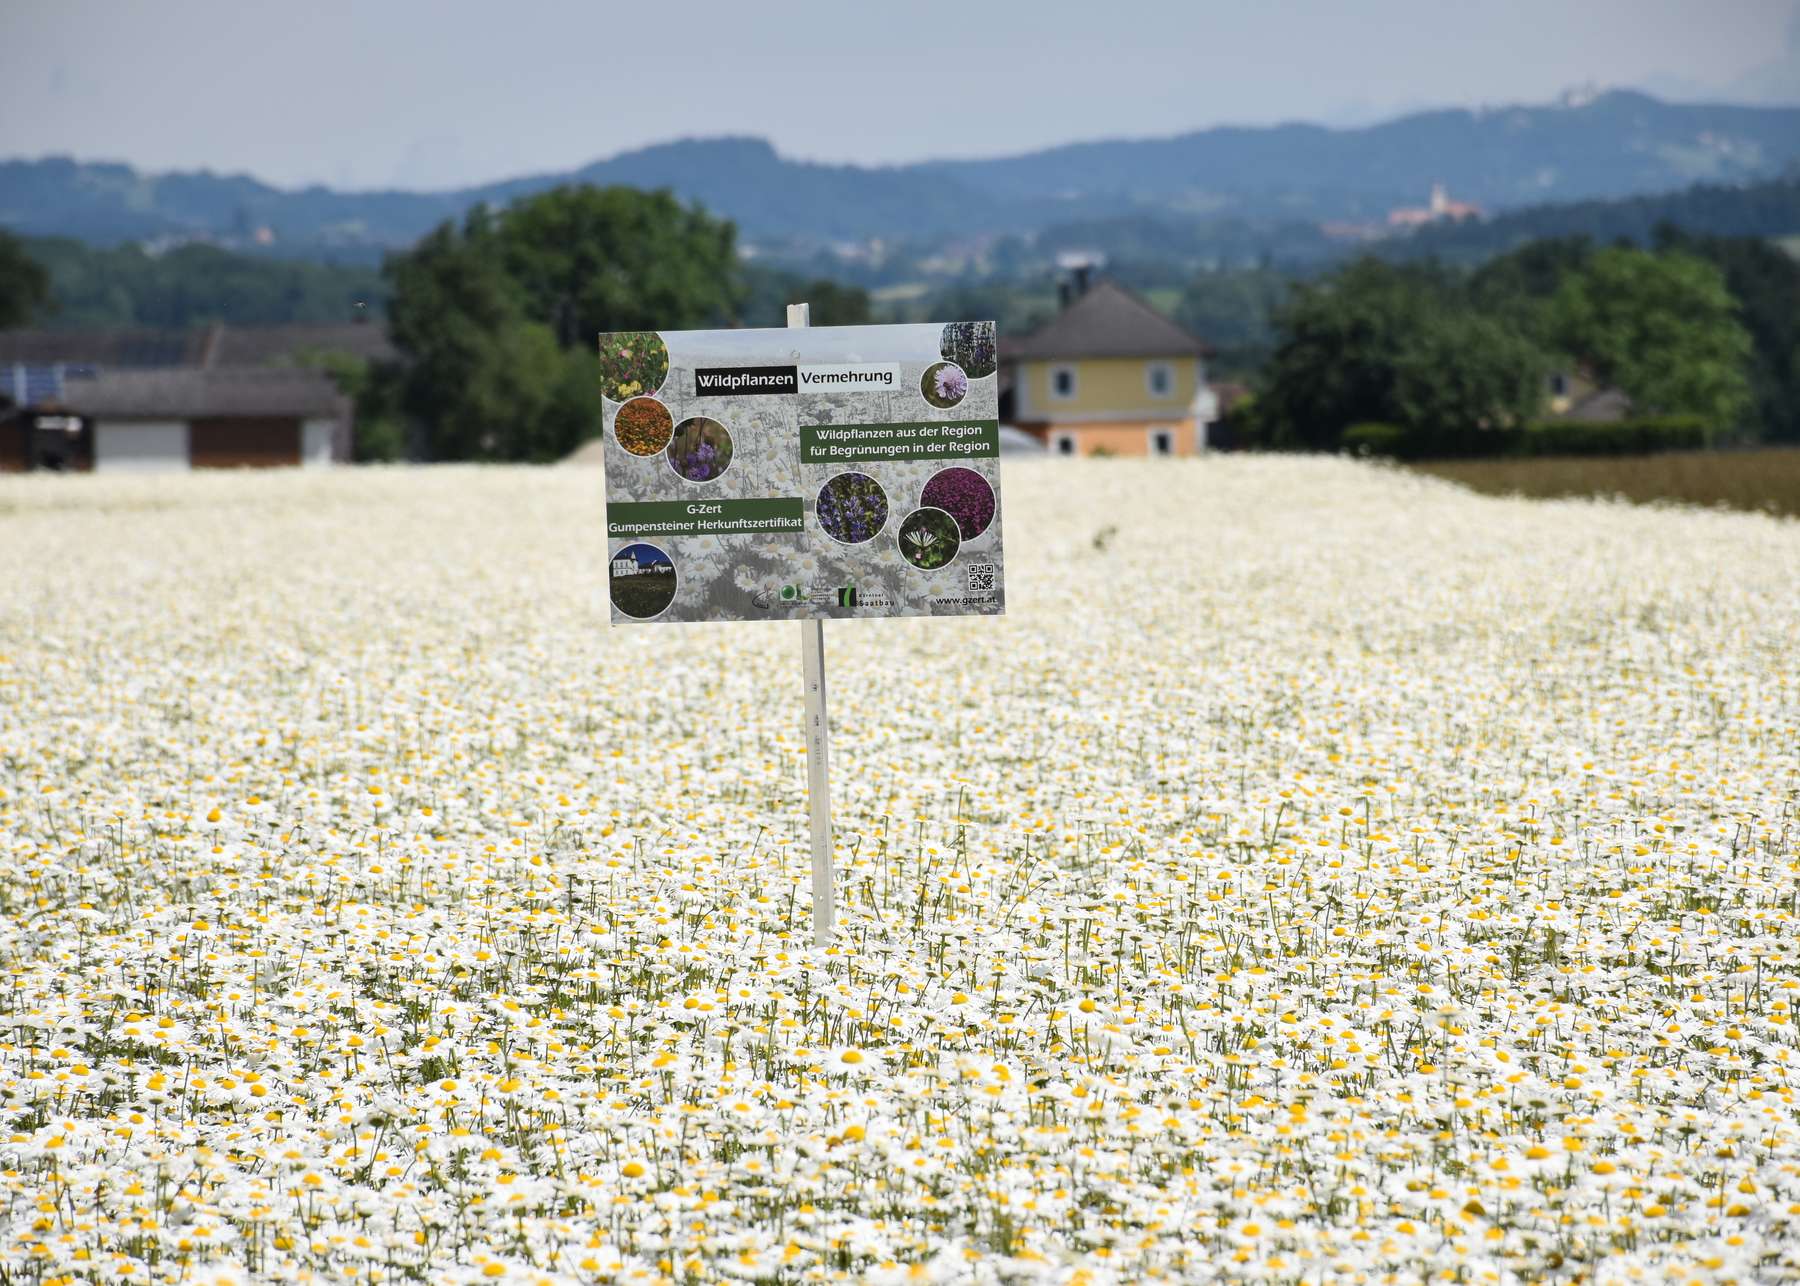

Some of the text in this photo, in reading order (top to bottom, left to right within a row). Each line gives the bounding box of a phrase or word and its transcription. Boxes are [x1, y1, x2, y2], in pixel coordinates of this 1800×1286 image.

[698, 371, 893, 389] Wildpflanzen Vermehrung
[817, 425, 983, 441] Wildpflanzen aus der Region
[810, 441, 990, 457] für Begrünungen in der Region
[687, 504, 722, 514] G-Zert
[608, 517, 802, 533] Gumpensteiner Herkunftszertifikat
[859, 599, 895, 607] Saatbau
[935, 596, 996, 605] www.gzert.at
